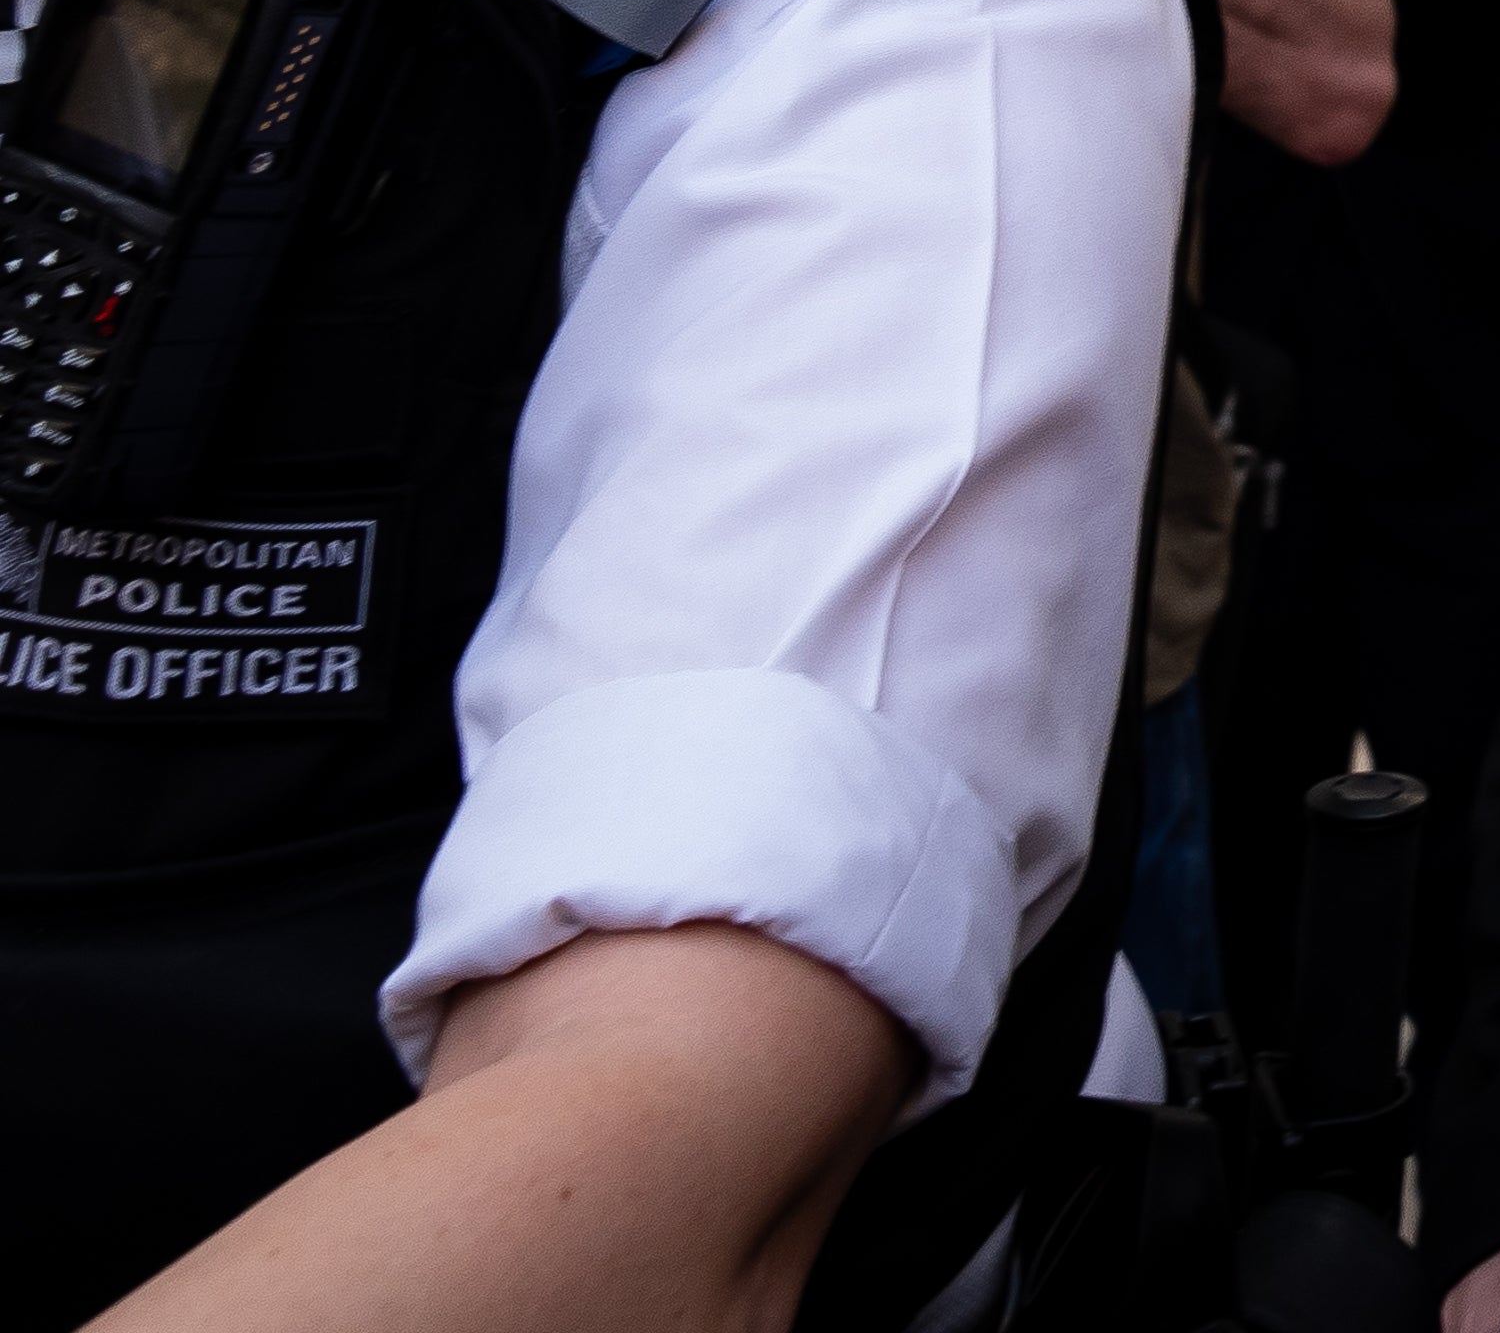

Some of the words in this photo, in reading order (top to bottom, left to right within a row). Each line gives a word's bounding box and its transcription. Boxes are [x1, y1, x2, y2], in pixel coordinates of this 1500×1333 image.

[54, 526, 355, 570] METROPOLITAN
[78, 575, 308, 617] POLICE
[106, 645, 361, 700] OFFICER
